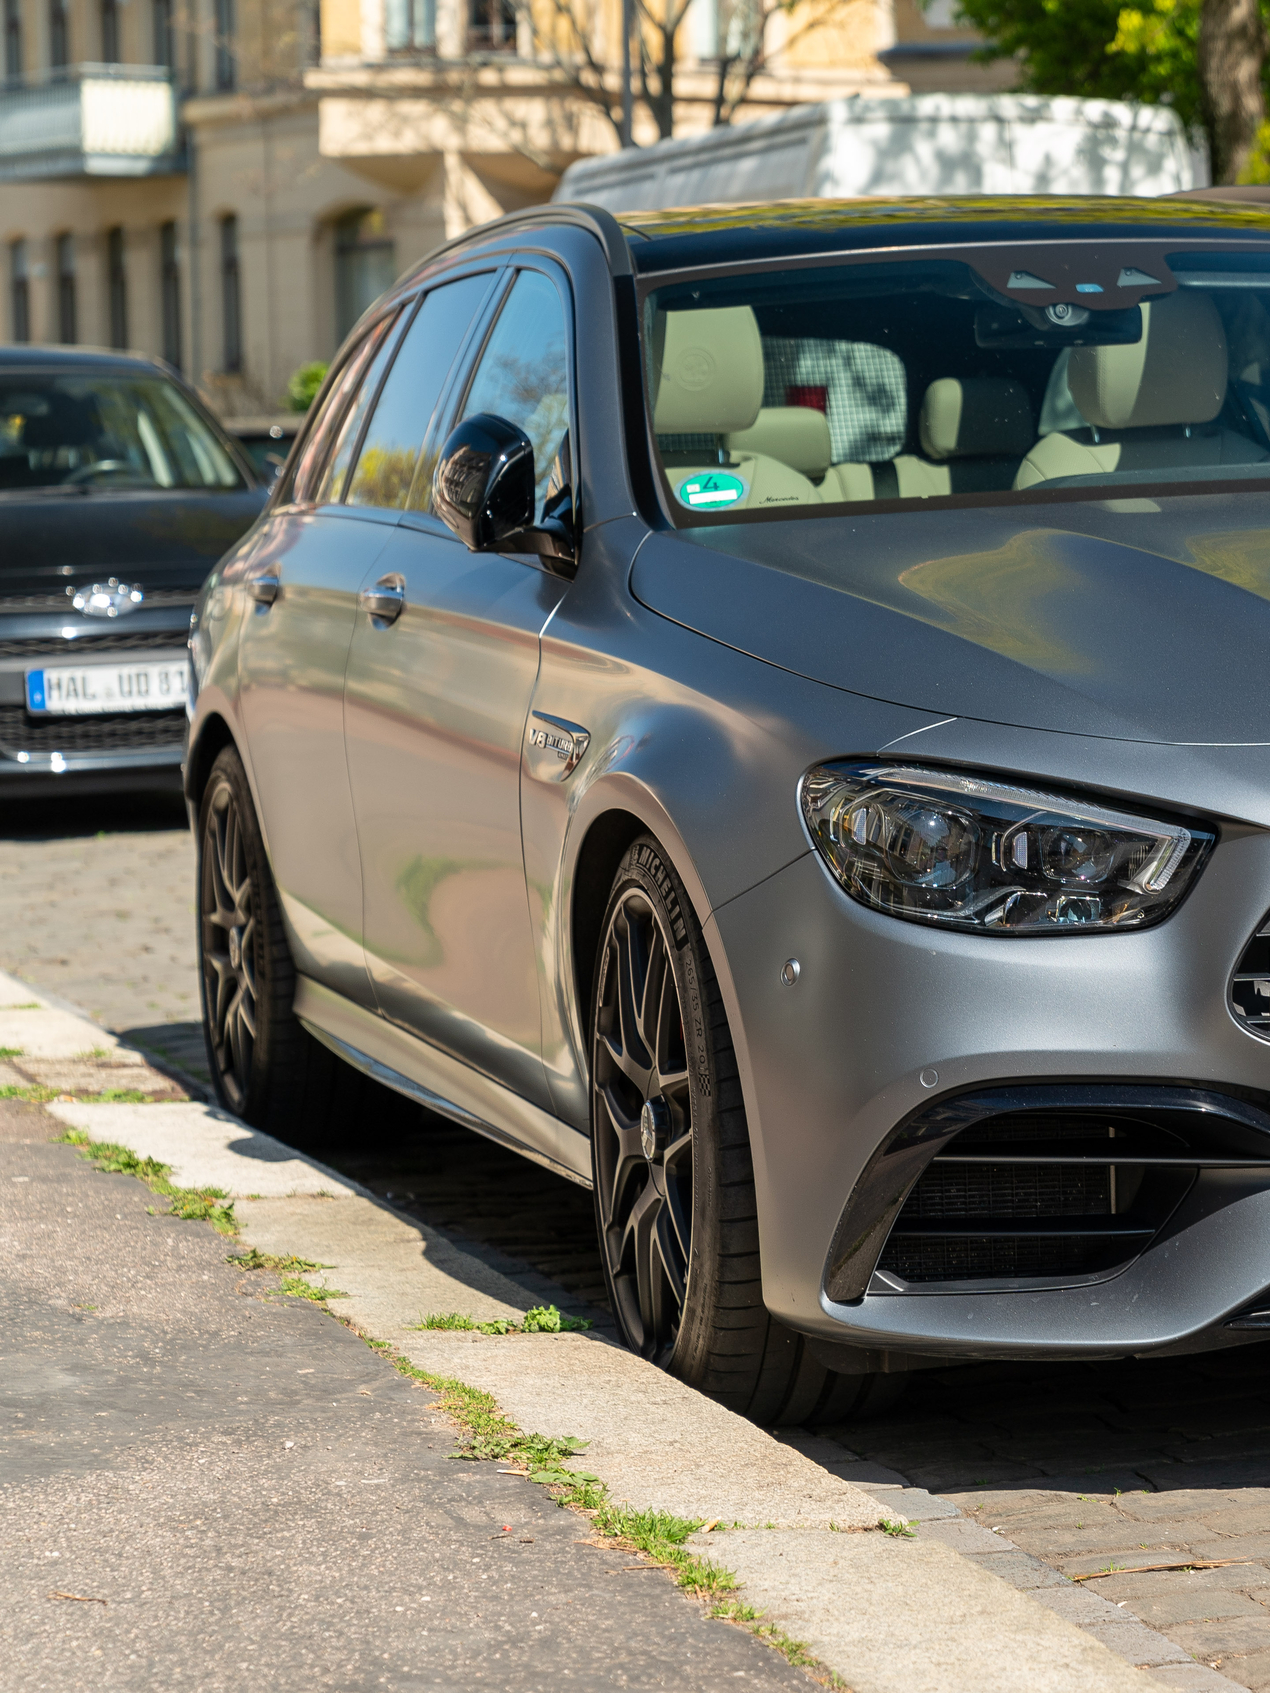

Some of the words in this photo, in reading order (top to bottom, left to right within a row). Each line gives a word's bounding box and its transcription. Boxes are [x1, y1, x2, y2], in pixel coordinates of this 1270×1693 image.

[702, 476, 720, 490] 4
[47, 673, 96, 701] HAL
[638, 846, 686, 941] MICHELIN
[685, 959, 700, 1011] 265/35
[694, 1017, 703, 1037] ZR
[697, 1045, 706, 1064] 20
